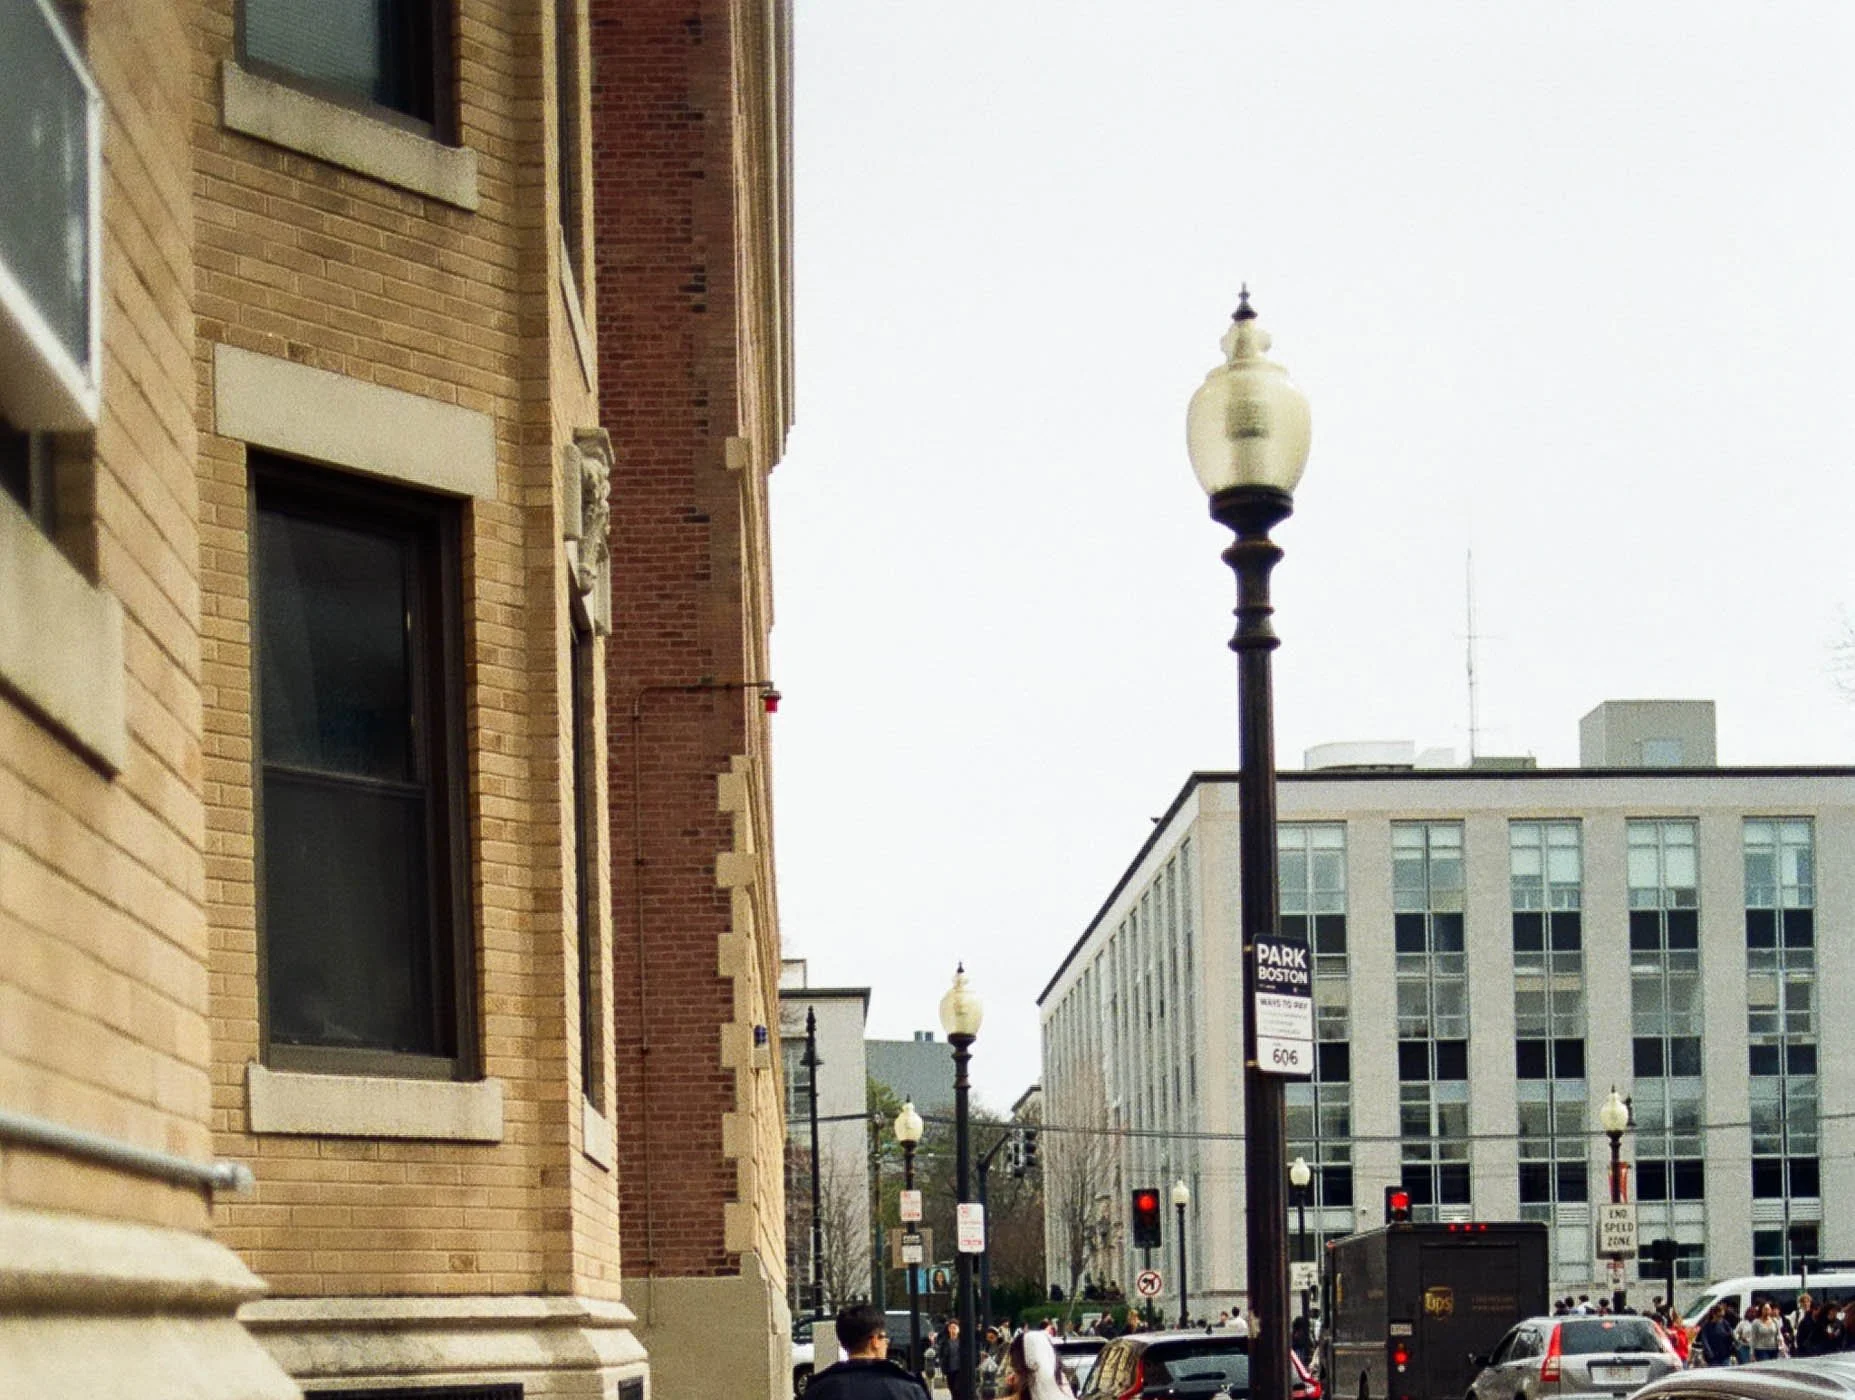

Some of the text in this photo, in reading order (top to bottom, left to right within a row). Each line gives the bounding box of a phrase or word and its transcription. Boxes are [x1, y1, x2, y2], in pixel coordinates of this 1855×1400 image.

[1257, 943, 1306, 968] PARK
[1258, 966, 1308, 983] BOSTON
[1273, 1048, 1298, 1066] 606
[1604, 1222, 1634, 1233] SPEED
